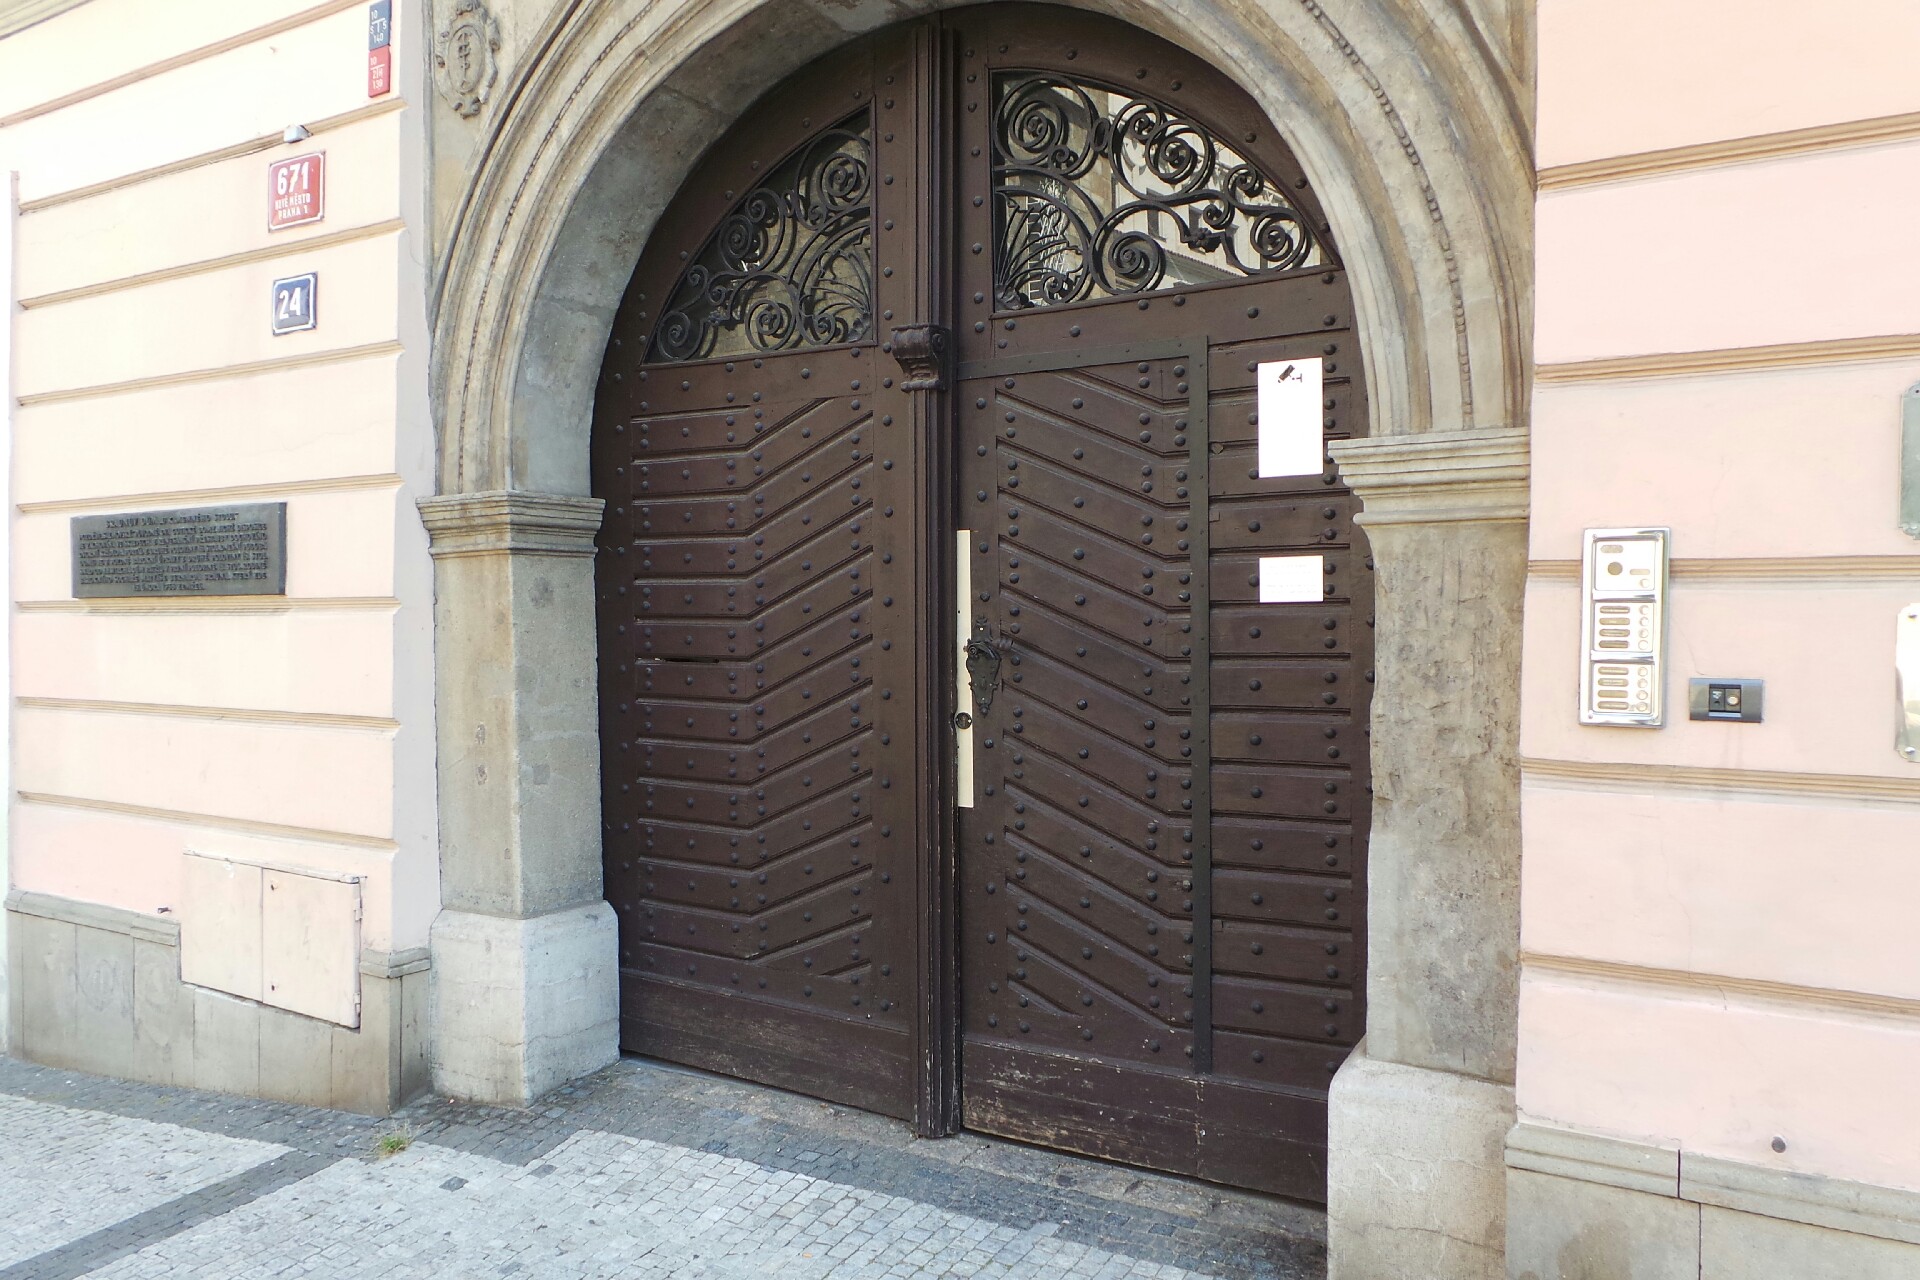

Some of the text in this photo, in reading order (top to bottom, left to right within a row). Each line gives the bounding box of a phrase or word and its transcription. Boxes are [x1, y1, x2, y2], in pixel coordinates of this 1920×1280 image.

[277, 161, 310, 195] 671
[278, 205, 308, 220] PRAHA 1
[279, 287, 301, 320] 24
